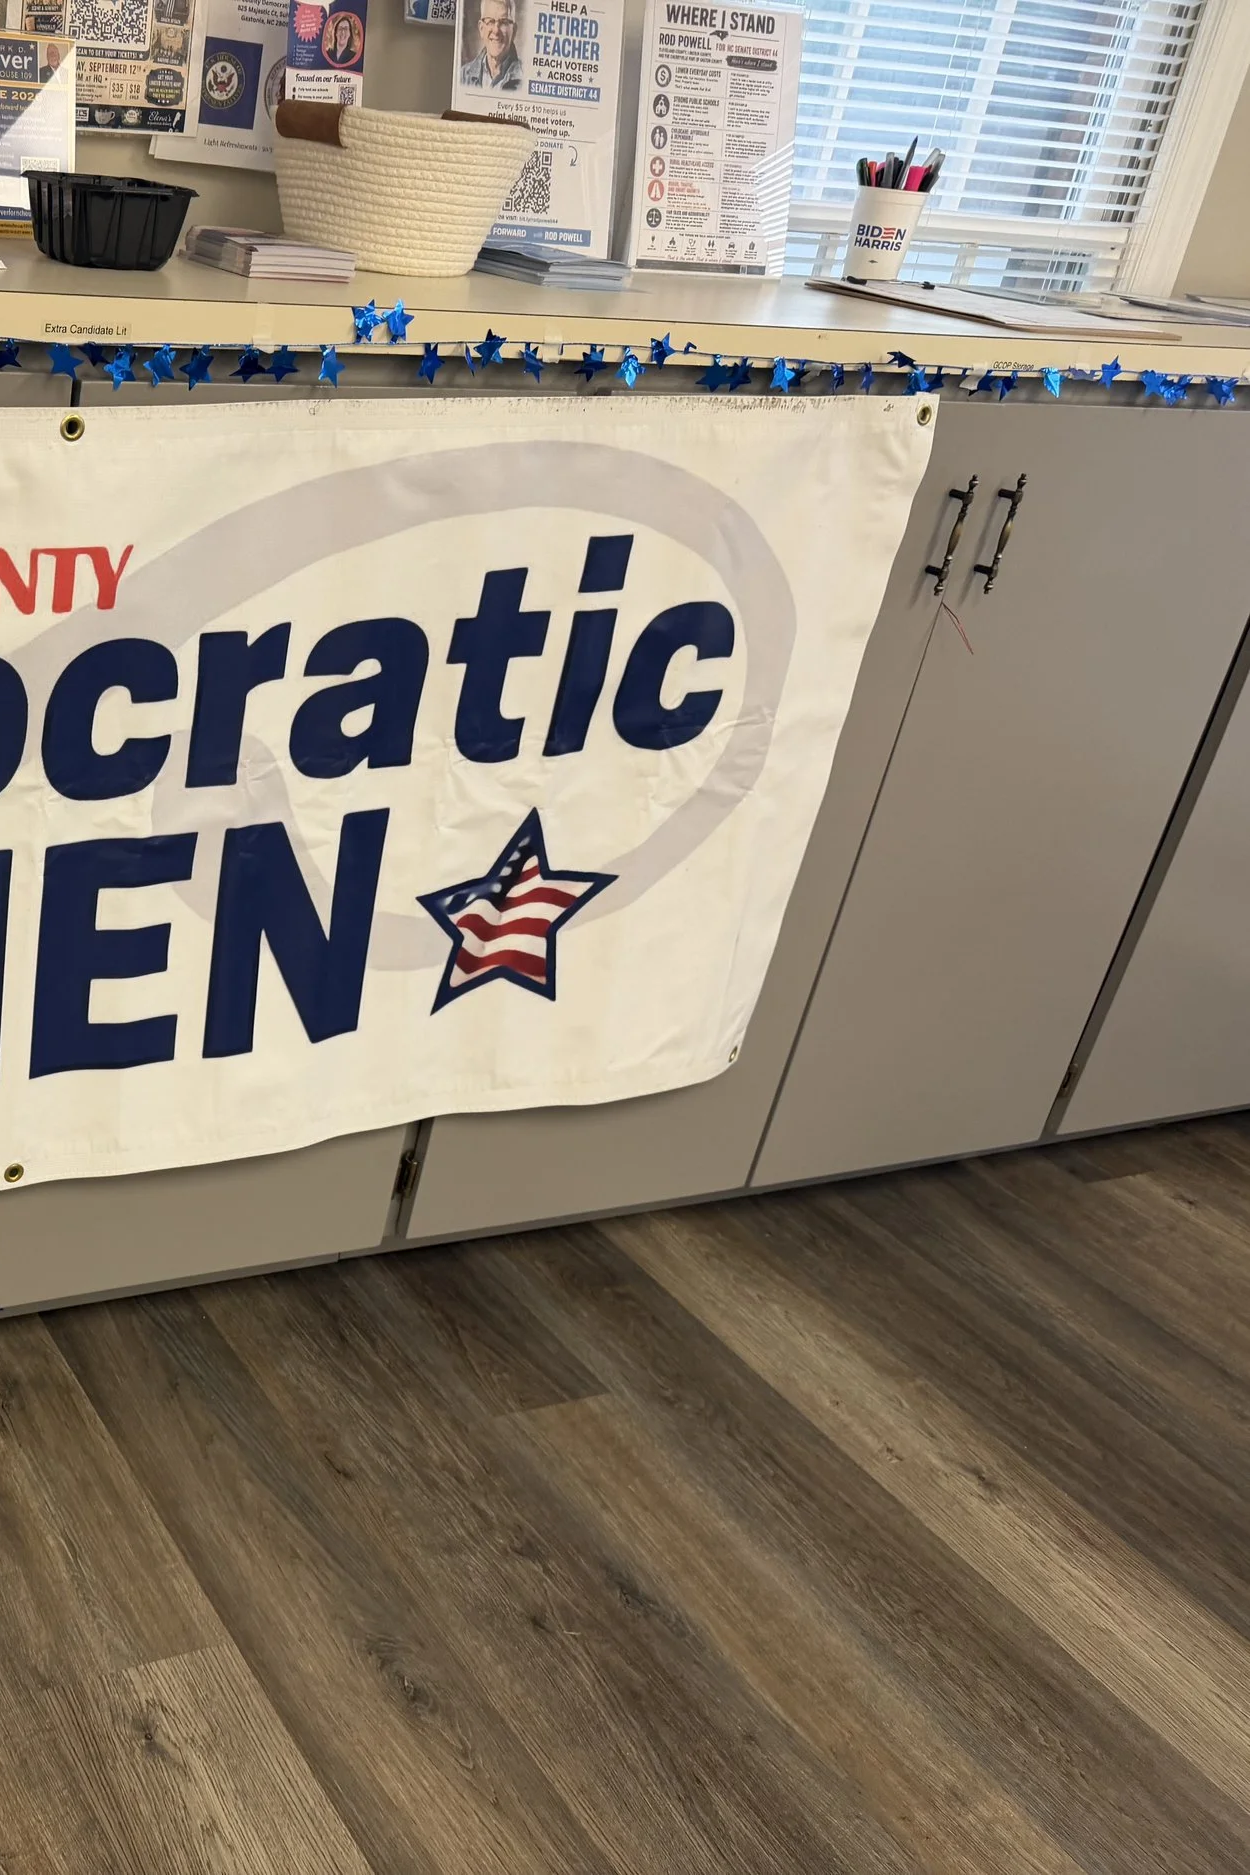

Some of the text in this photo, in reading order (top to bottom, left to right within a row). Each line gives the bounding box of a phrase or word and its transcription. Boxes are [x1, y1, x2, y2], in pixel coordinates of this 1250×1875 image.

[551, 1, 587, 16] HELP A
[538, 12, 598, 39] RETIRED
[666, 4, 775, 34] WHERE I STAND
[534, 34, 600, 61] TEACHER
[659, 33, 712, 50] ROD POWELL
[716, 43, 726, 52] FOR
[727, 44, 734, 53] NC
[735, 45, 751, 55] SENATE
[752, 47, 771, 56] DISTRICT
[89, 62, 127, 74] SEPTEMBER
[533, 57, 599, 73] REACH VOTERS
[93, 74, 103, 82] HQ
[295, 73, 315, 82] Focused
[334, 74, 351, 83] Future
[548, 71, 583, 83] ACROSS
[112, 83, 124, 93] $35
[130, 84, 140, 94] $18
[531, 82, 598, 99] SENATE DISTRICT 44
[497, 102, 513, 111] Every
[515, 103, 523, 111] $5
[532, 105, 542, 113] $10
[543, 107, 558, 115] helps
[530, 116, 548, 125] meet
[550, 119, 575, 128] voters,
[532, 125, 570, 138] howing up.
[540, 141, 563, 149] DONATE
[493, 227, 526, 237] FORWARD
[545, 231, 557, 240] ROD
[559, 233, 583, 242] POWELL
[856, 224, 907, 241] BIDEN
[854, 236, 902, 251] HARRIS
[45, 323, 127, 336] Extra Candidate Lit
